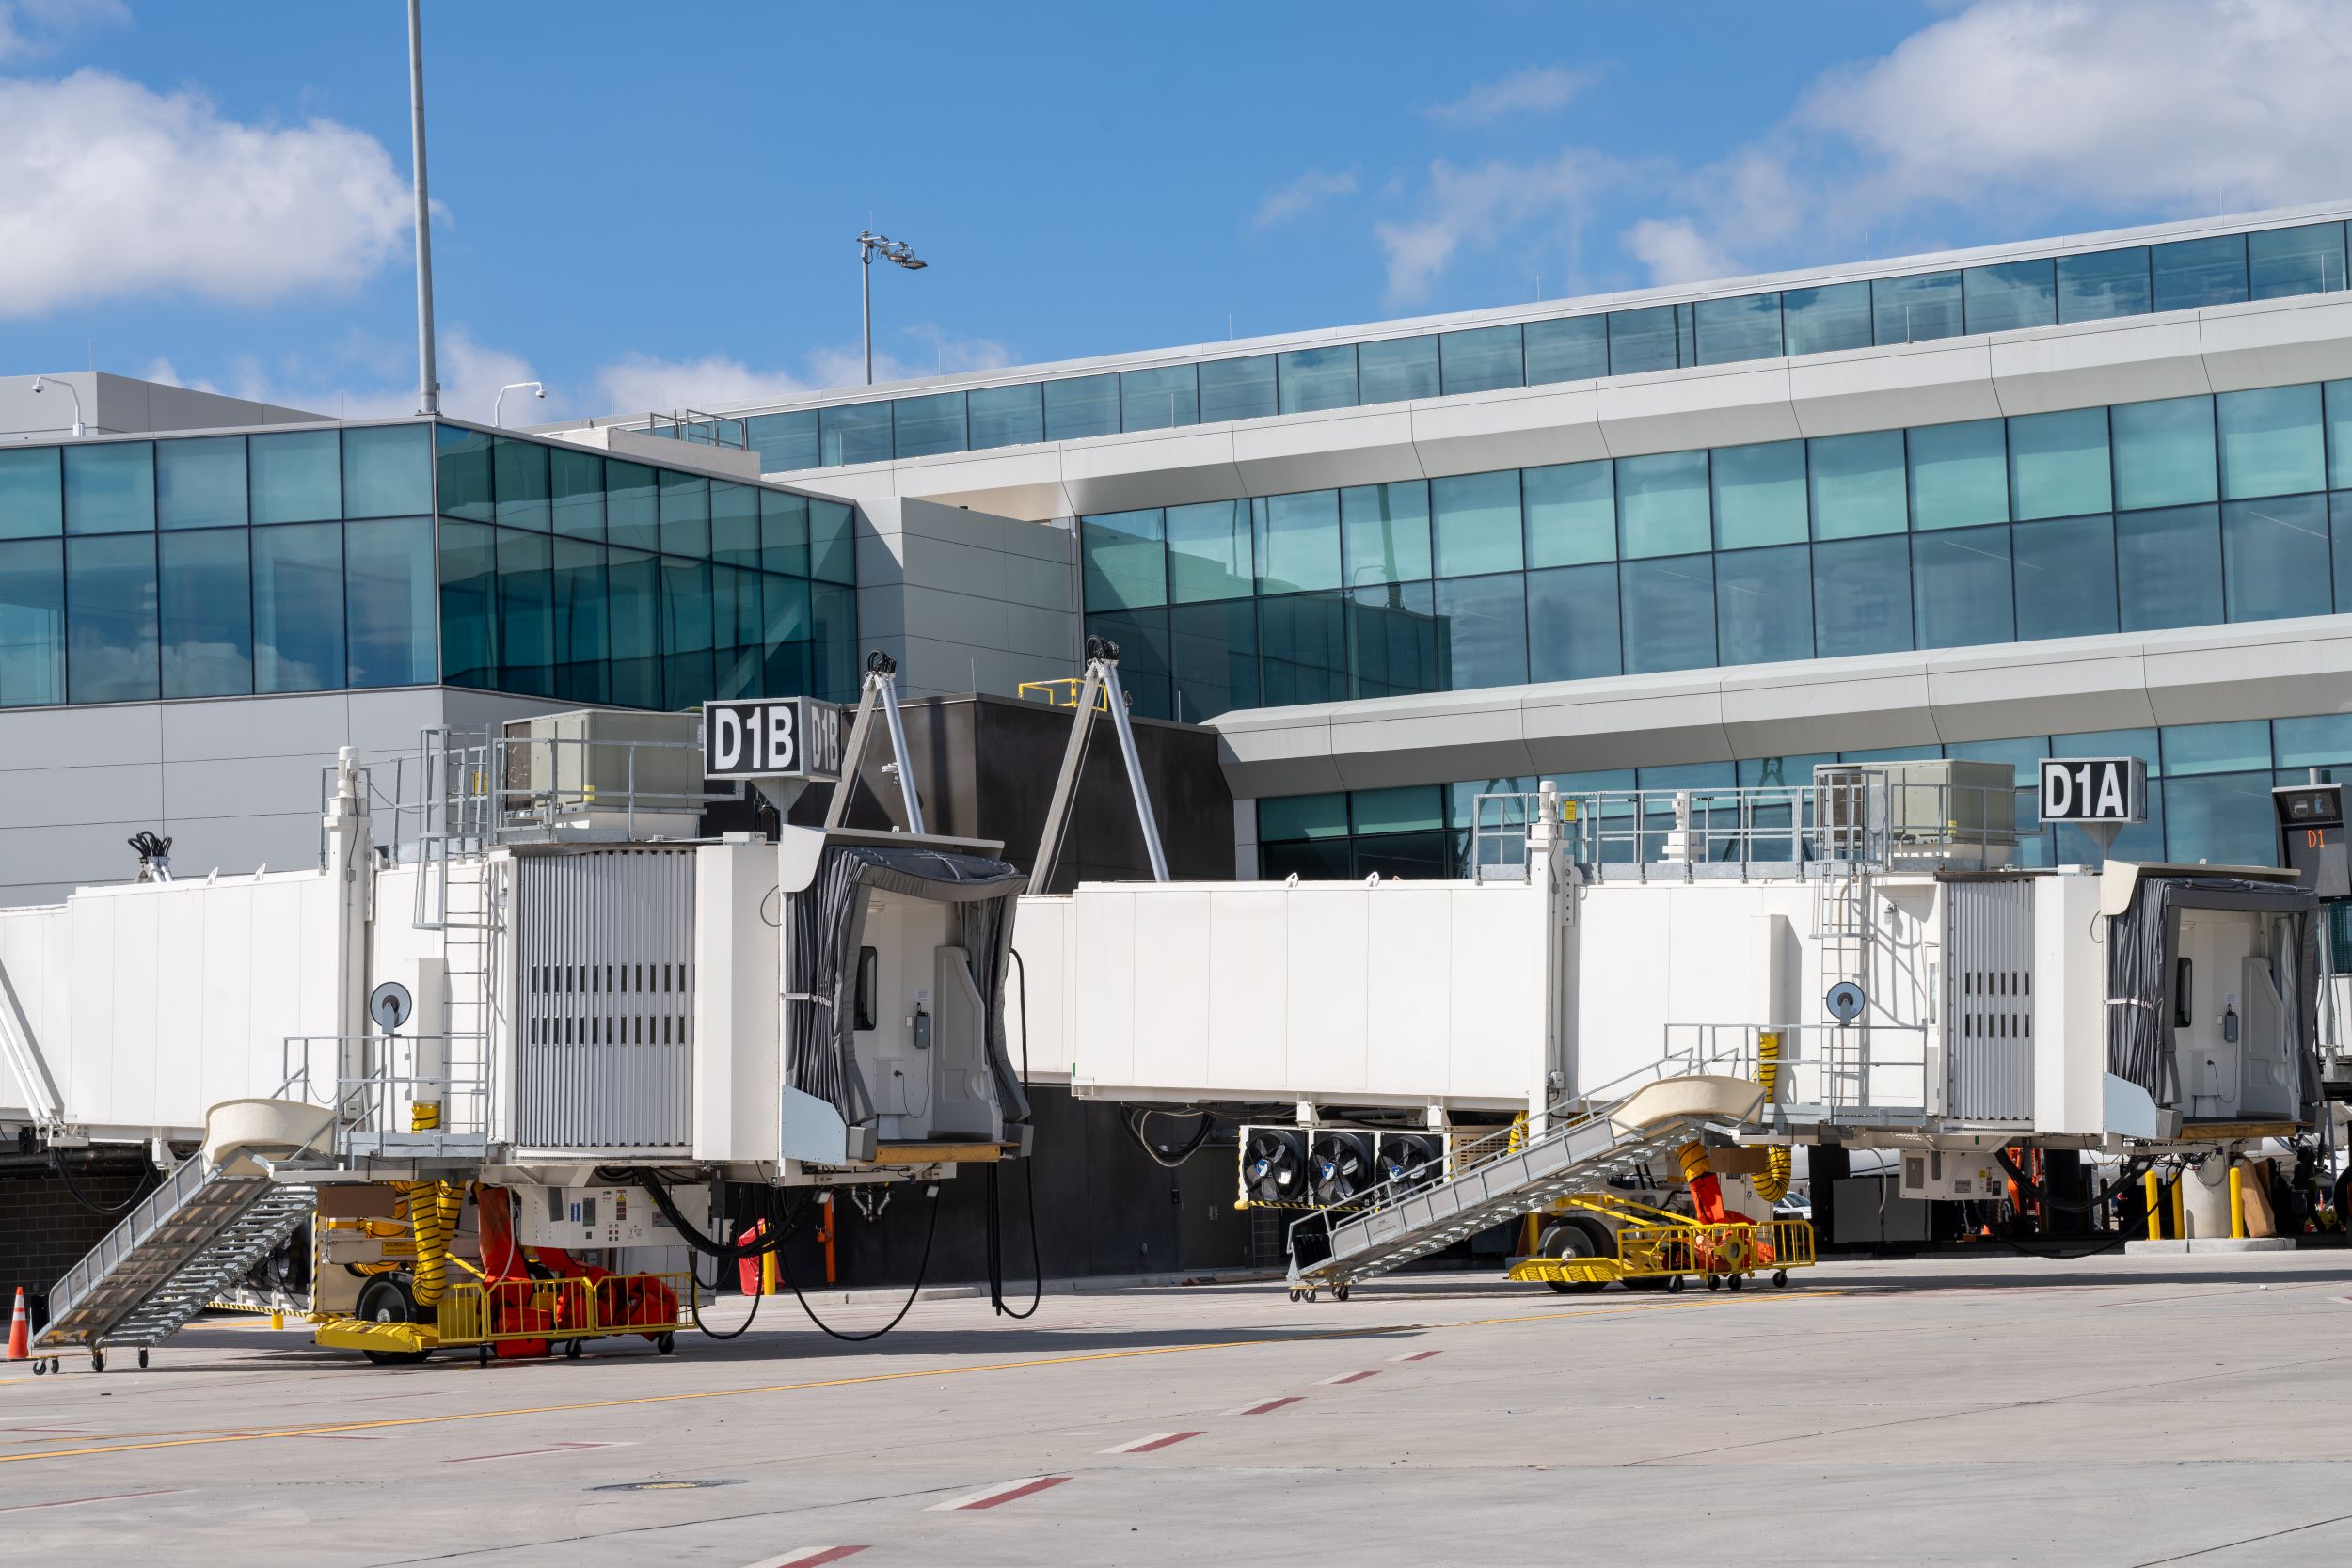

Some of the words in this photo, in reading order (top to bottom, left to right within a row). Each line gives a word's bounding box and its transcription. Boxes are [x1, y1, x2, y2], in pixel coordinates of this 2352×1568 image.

[715, 706, 793, 769] D1B
[811, 705, 838, 771] D1B
[2045, 763, 2124, 817] D1A
[2307, 828, 2325, 848] D1
